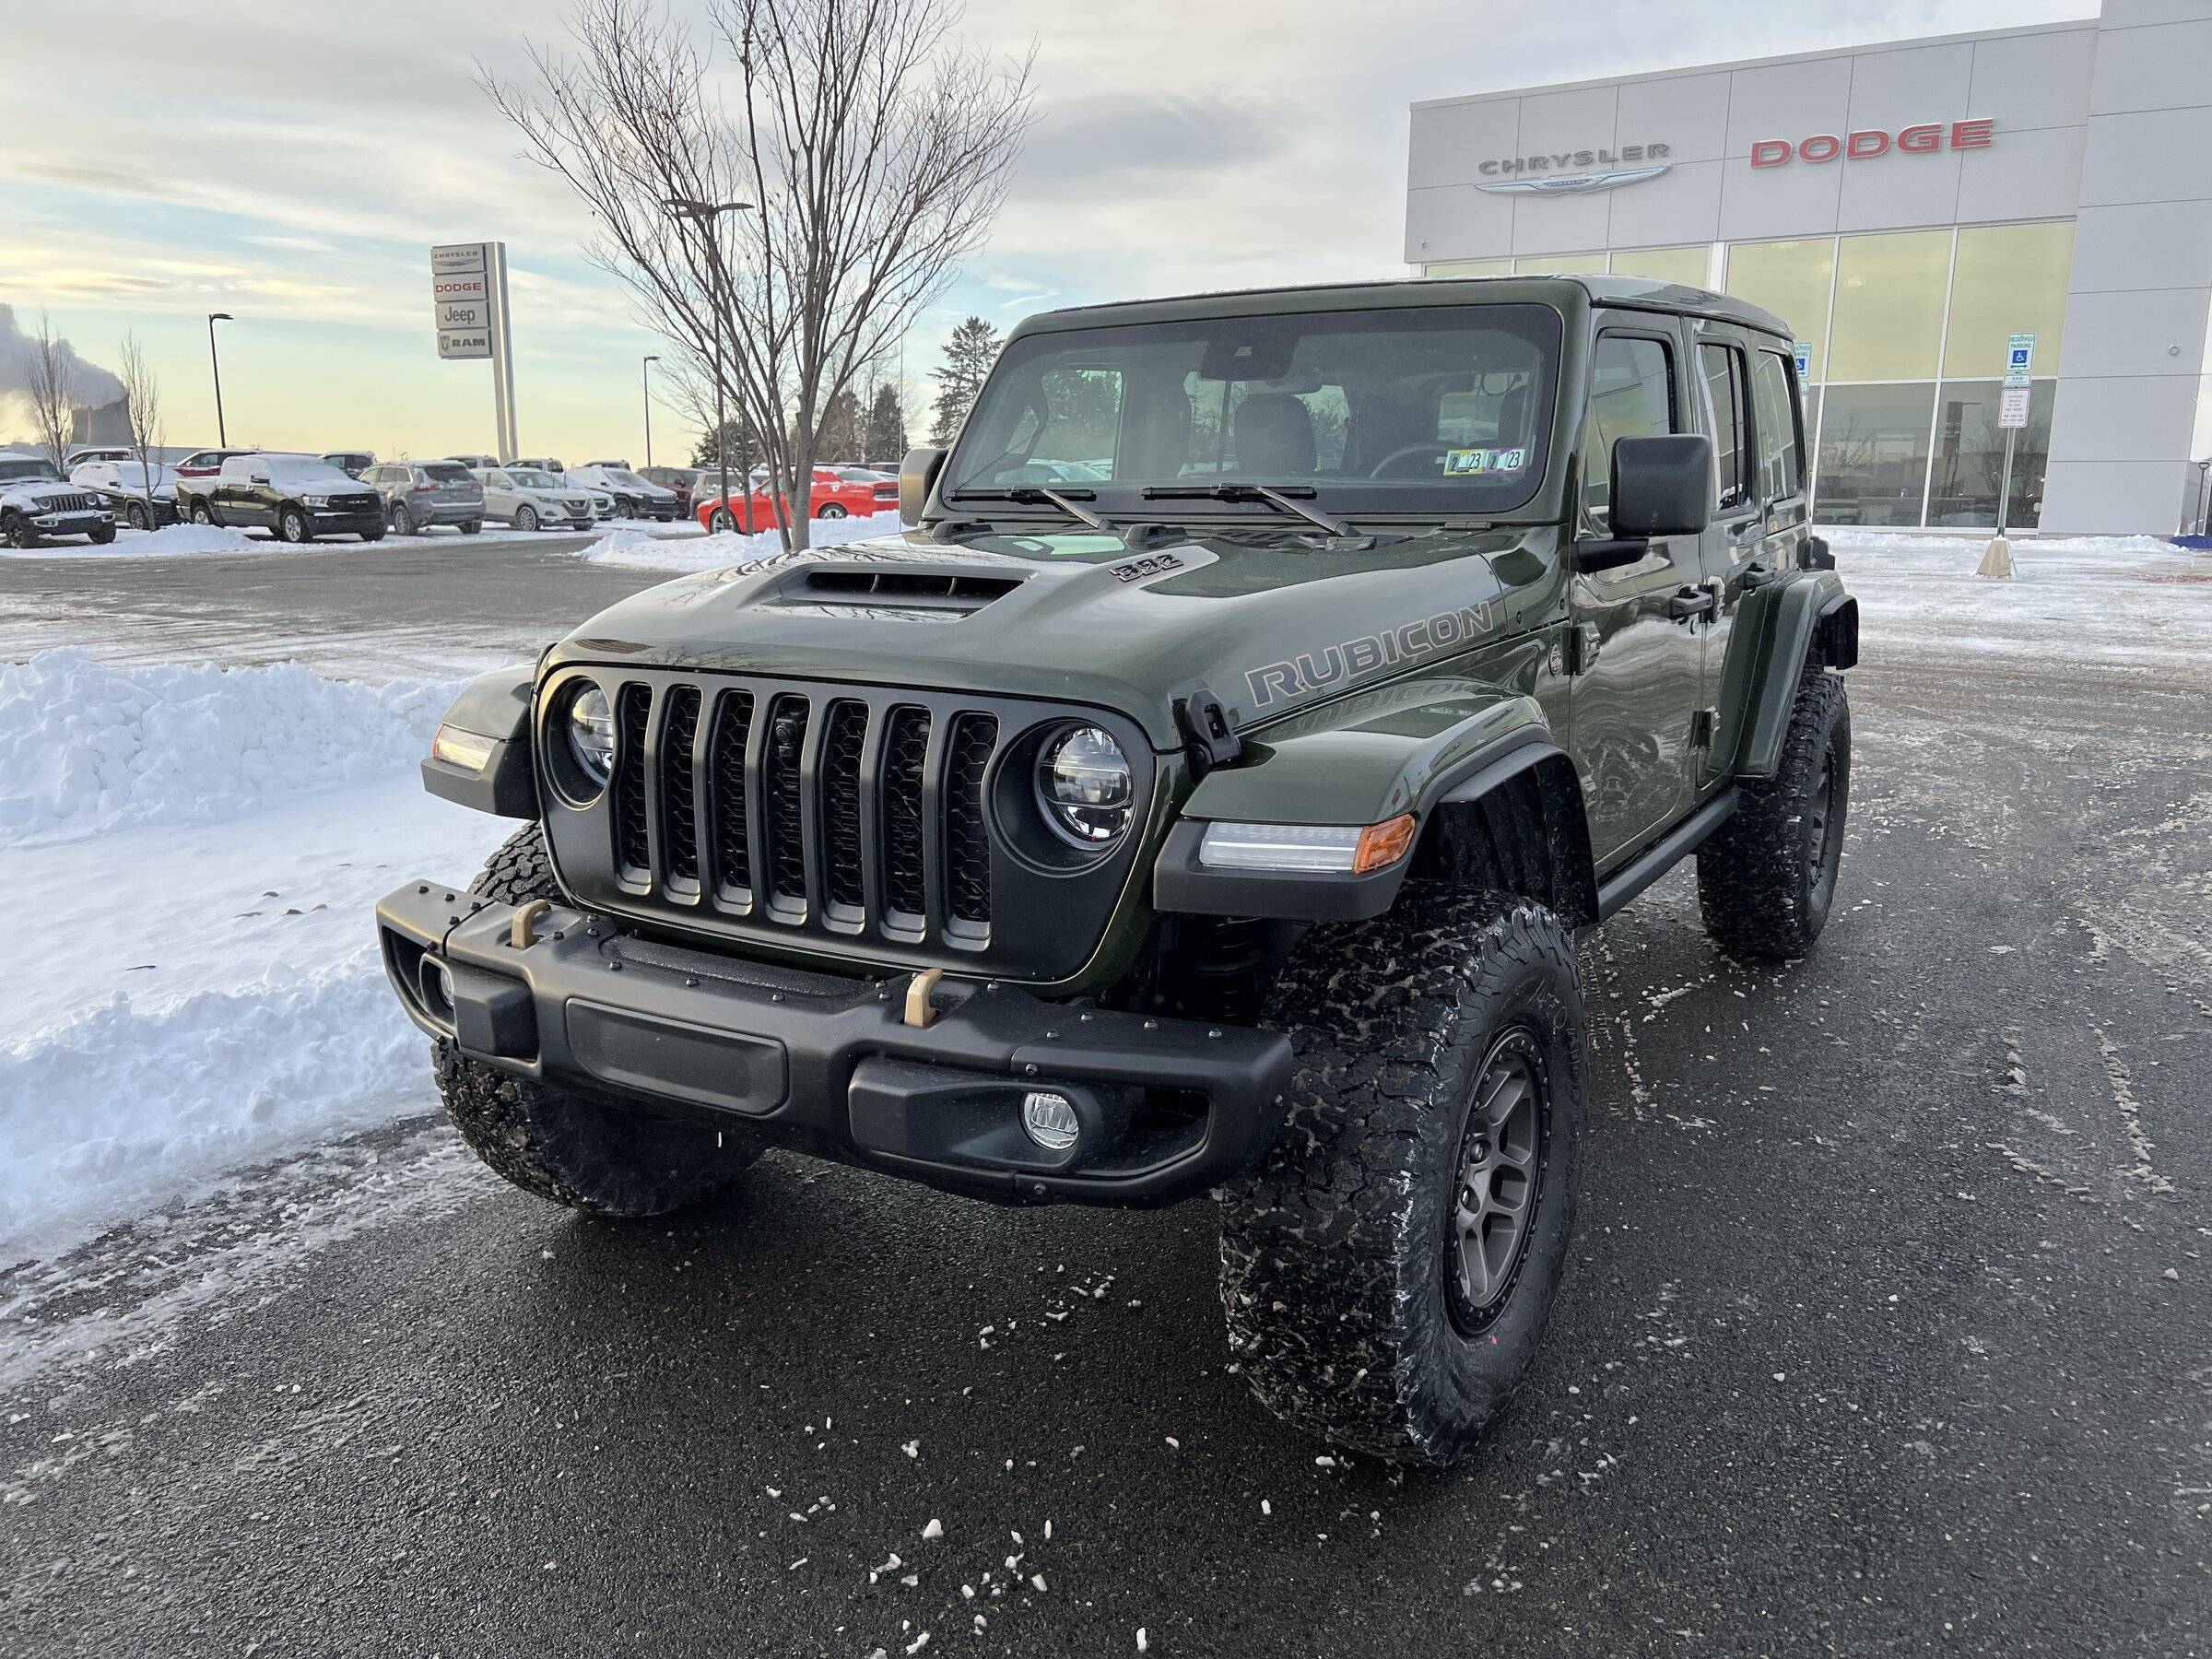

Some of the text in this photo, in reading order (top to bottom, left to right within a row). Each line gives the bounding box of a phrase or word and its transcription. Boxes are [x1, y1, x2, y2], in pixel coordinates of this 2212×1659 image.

[1750, 117, 1994, 168] DODGE
[1477, 143, 1670, 175] CHRYSLER
[433, 251, 478, 259] CHRYSLER
[435, 282, 481, 293] DODGE
[444, 306, 476, 324] Jeep
[452, 337, 487, 347] RAM
[1469, 453, 1482, 470] 23
[1507, 451, 1522, 468] 23
[1109, 554, 1183, 582] 392
[1244, 600, 1494, 708] RUBICON
